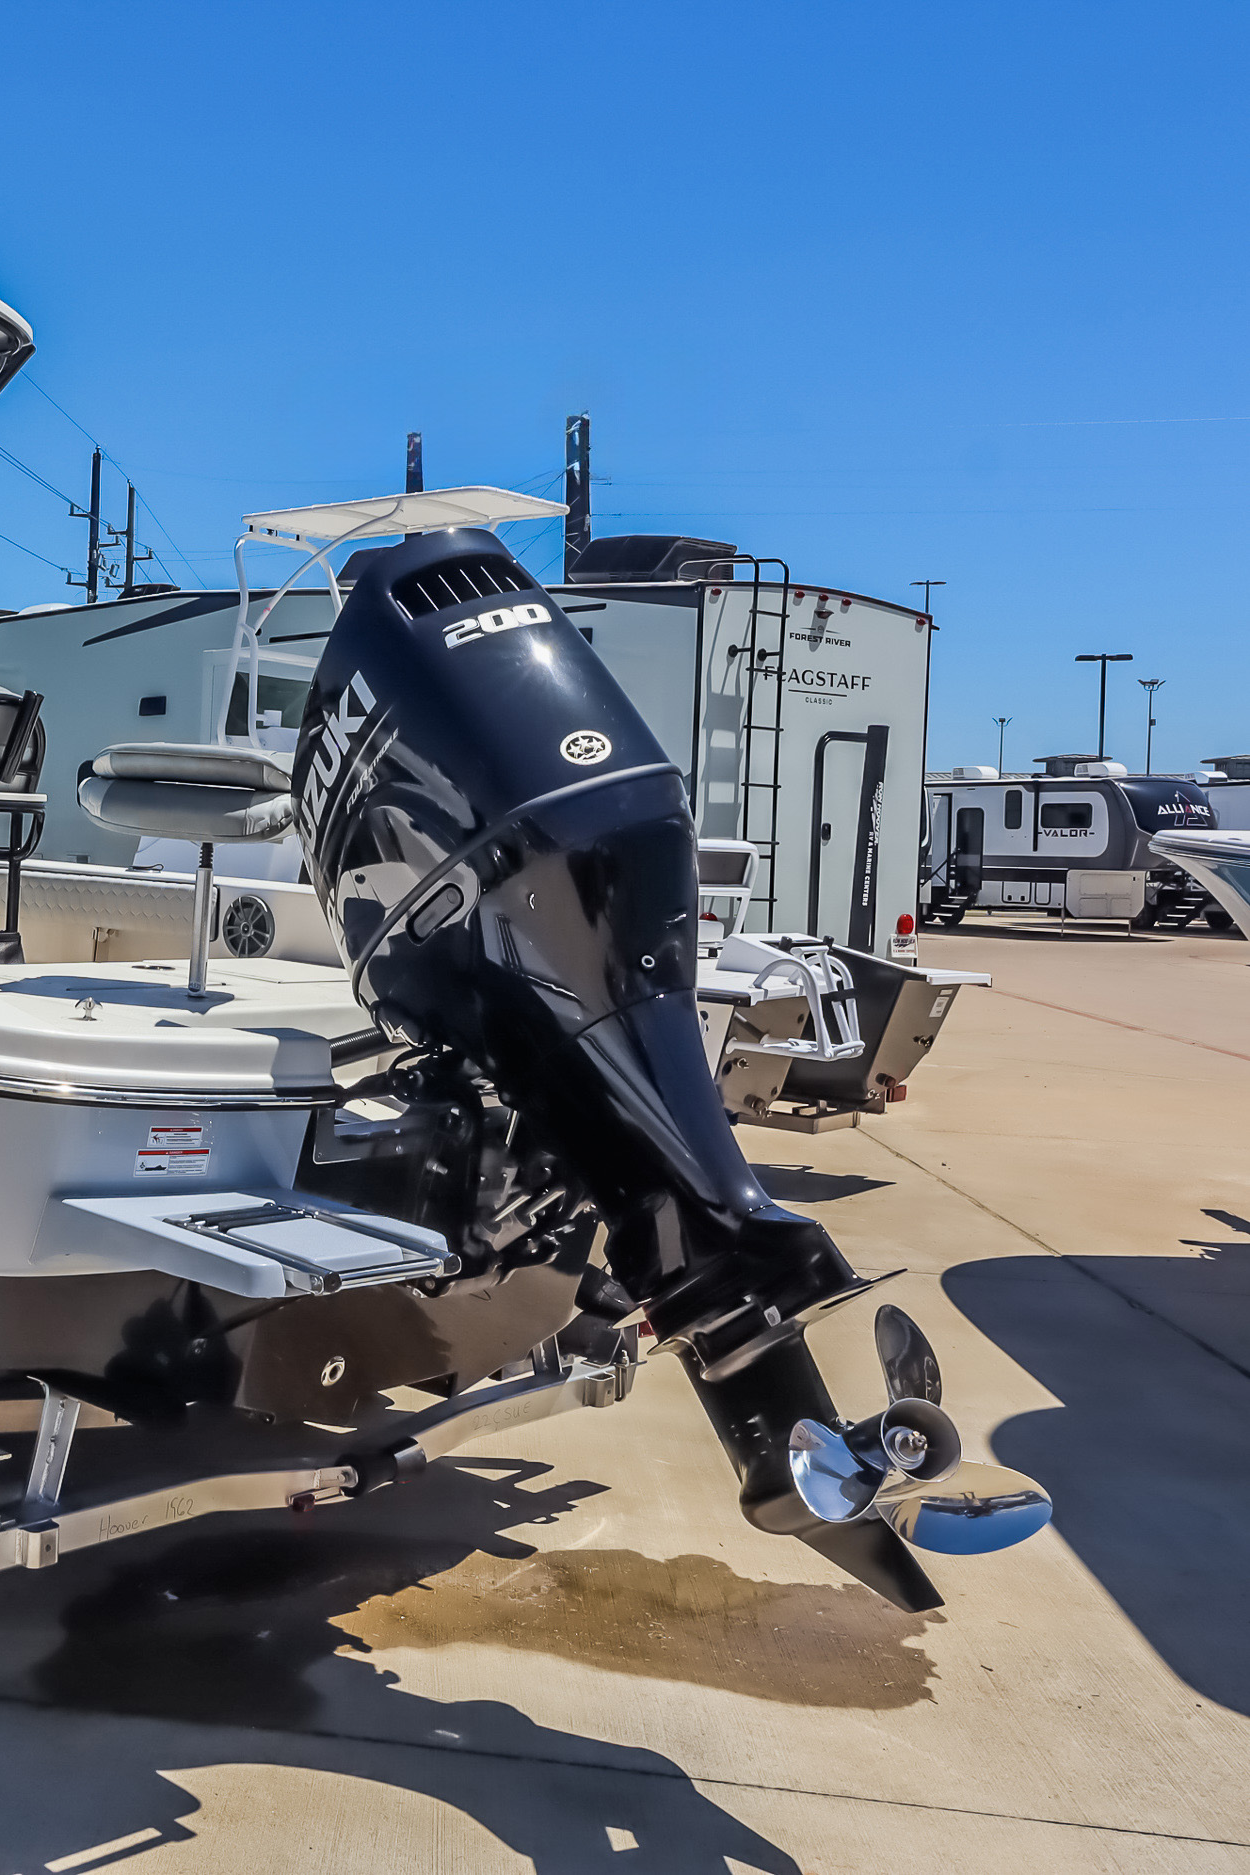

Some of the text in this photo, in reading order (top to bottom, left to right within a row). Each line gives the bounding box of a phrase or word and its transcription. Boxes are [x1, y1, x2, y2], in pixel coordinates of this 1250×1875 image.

[442, 603, 553, 650] 200
[789, 632, 851, 648] FOREST RIVER
[805, 697, 833, 706] CLASSIC
[300, 669, 378, 868] UZUKI
[1157, 802, 1212, 818] ALLIANCE
[98, 1514, 149, 1542] Hoover
